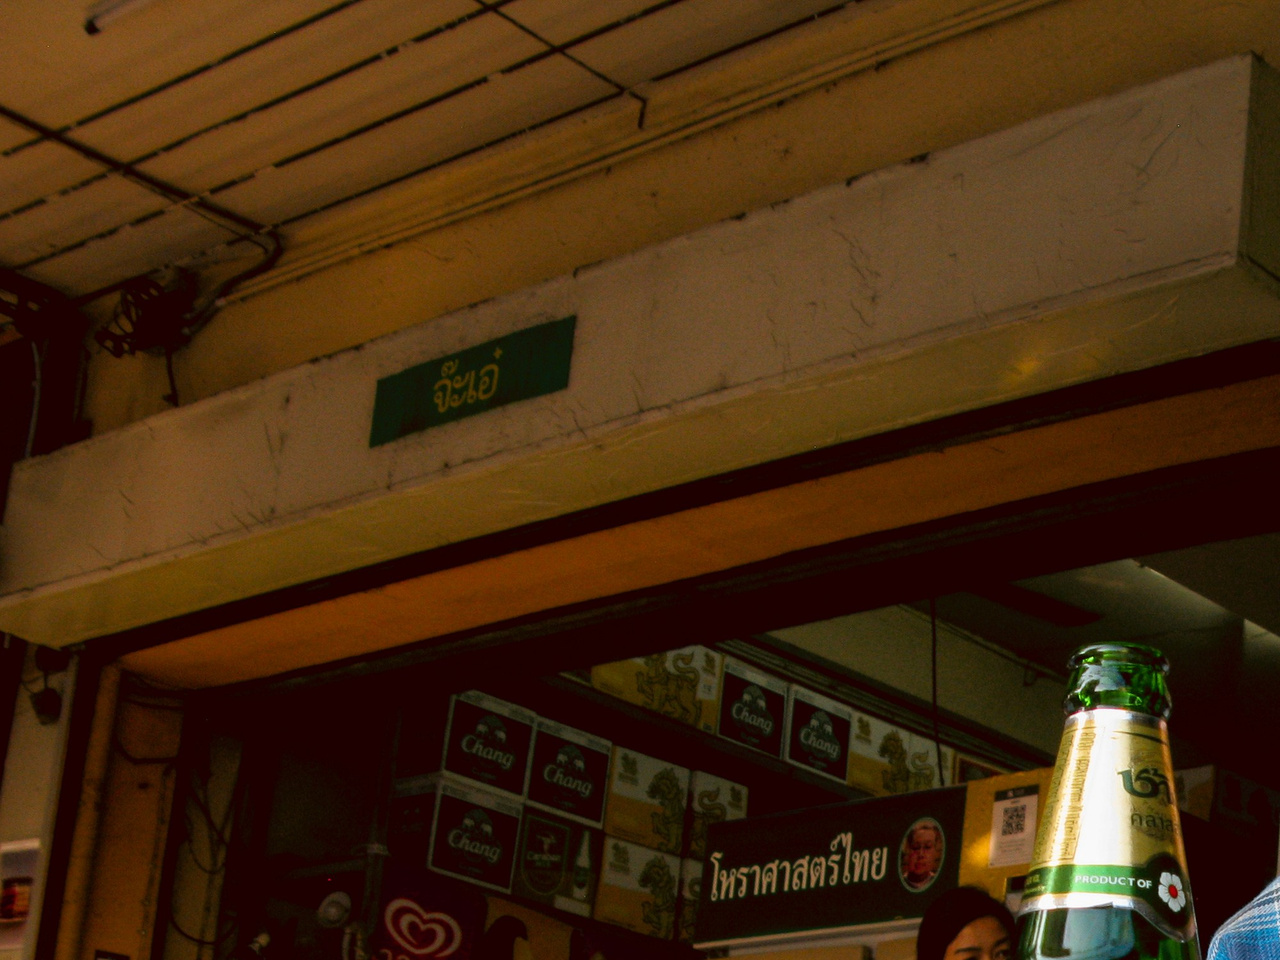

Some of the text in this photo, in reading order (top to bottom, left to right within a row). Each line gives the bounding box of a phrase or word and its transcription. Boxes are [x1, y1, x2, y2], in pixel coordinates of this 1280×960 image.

[732, 703, 773, 735] Chang
[460, 733, 514, 771] Chang
[800, 728, 840, 759] Chang
[543, 763, 593, 799] Chang
[447, 829, 500, 865] Chang
[709, 831, 889, 902] โหราศาสตร์ไทย
[1075, 875, 1152, 889] PRODUCT OF
